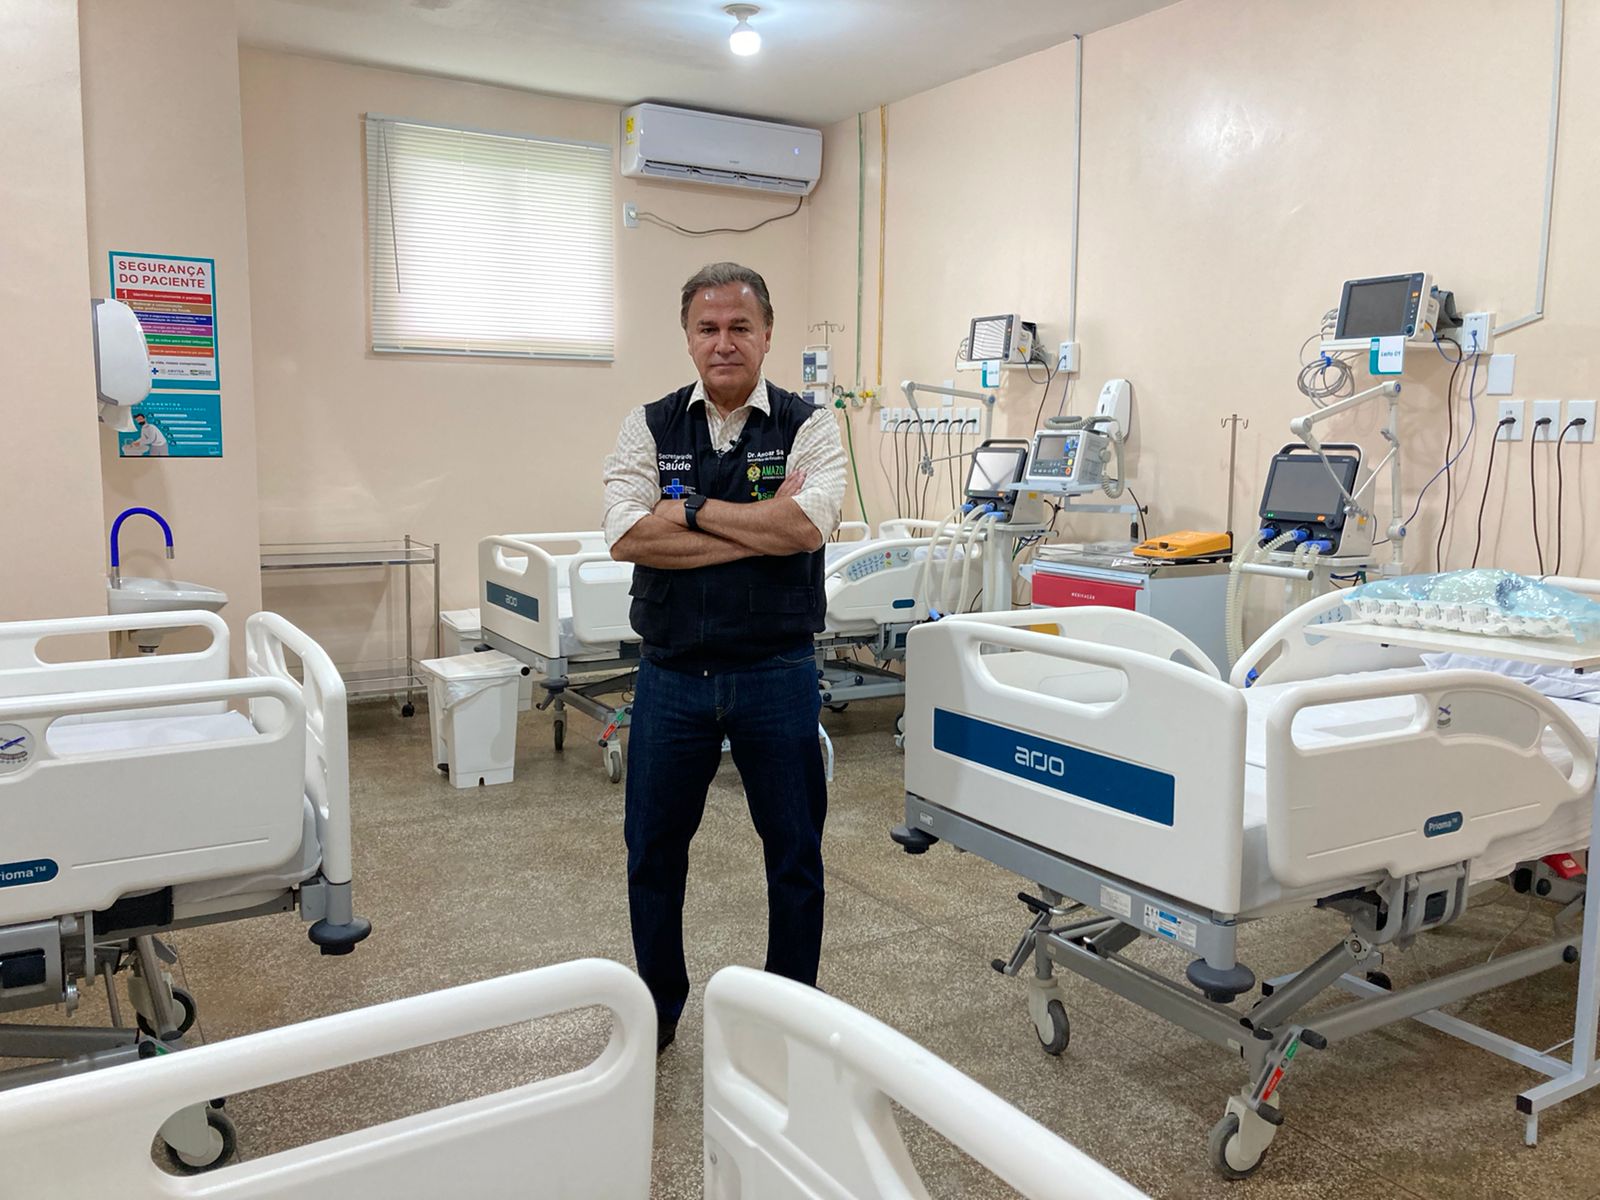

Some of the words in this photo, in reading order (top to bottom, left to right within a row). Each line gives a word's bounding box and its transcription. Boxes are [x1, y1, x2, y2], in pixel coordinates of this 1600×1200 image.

[119, 260, 205, 276] SEGURANÇA
[119, 273, 139, 284] DO
[142, 275, 205, 288] PACIENTE
[122, 290, 128, 300] 1
[658, 459, 692, 471] Saúde
